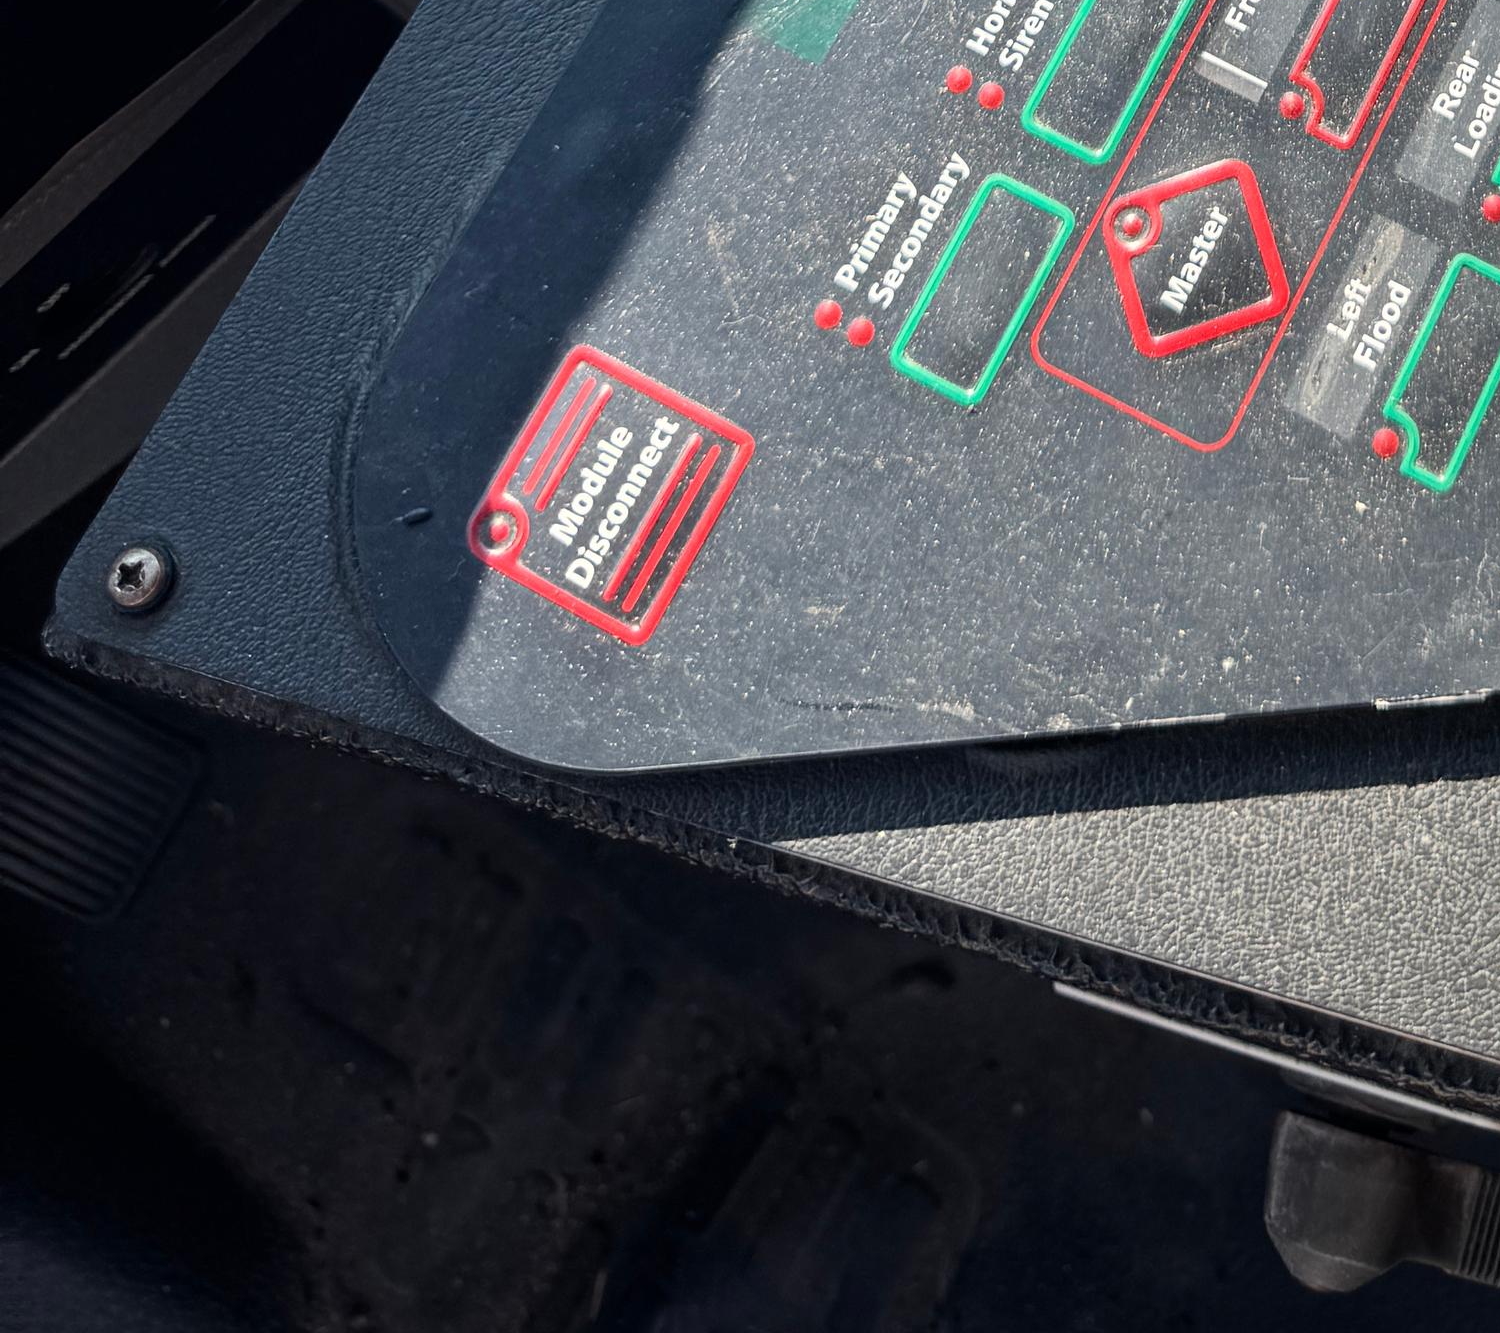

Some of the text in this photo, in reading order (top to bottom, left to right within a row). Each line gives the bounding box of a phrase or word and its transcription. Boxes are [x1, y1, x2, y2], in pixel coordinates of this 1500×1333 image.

[1431, 50, 1478, 121] Rear
[834, 171, 918, 292] Primary
[867, 151, 971, 310] Secondary
[1159, 205, 1229, 314] Master
[1327, 278, 1372, 342] Left
[1353, 279, 1412, 373] Flood
[549, 425, 633, 546] Module
[564, 415, 680, 590] Disconnect
